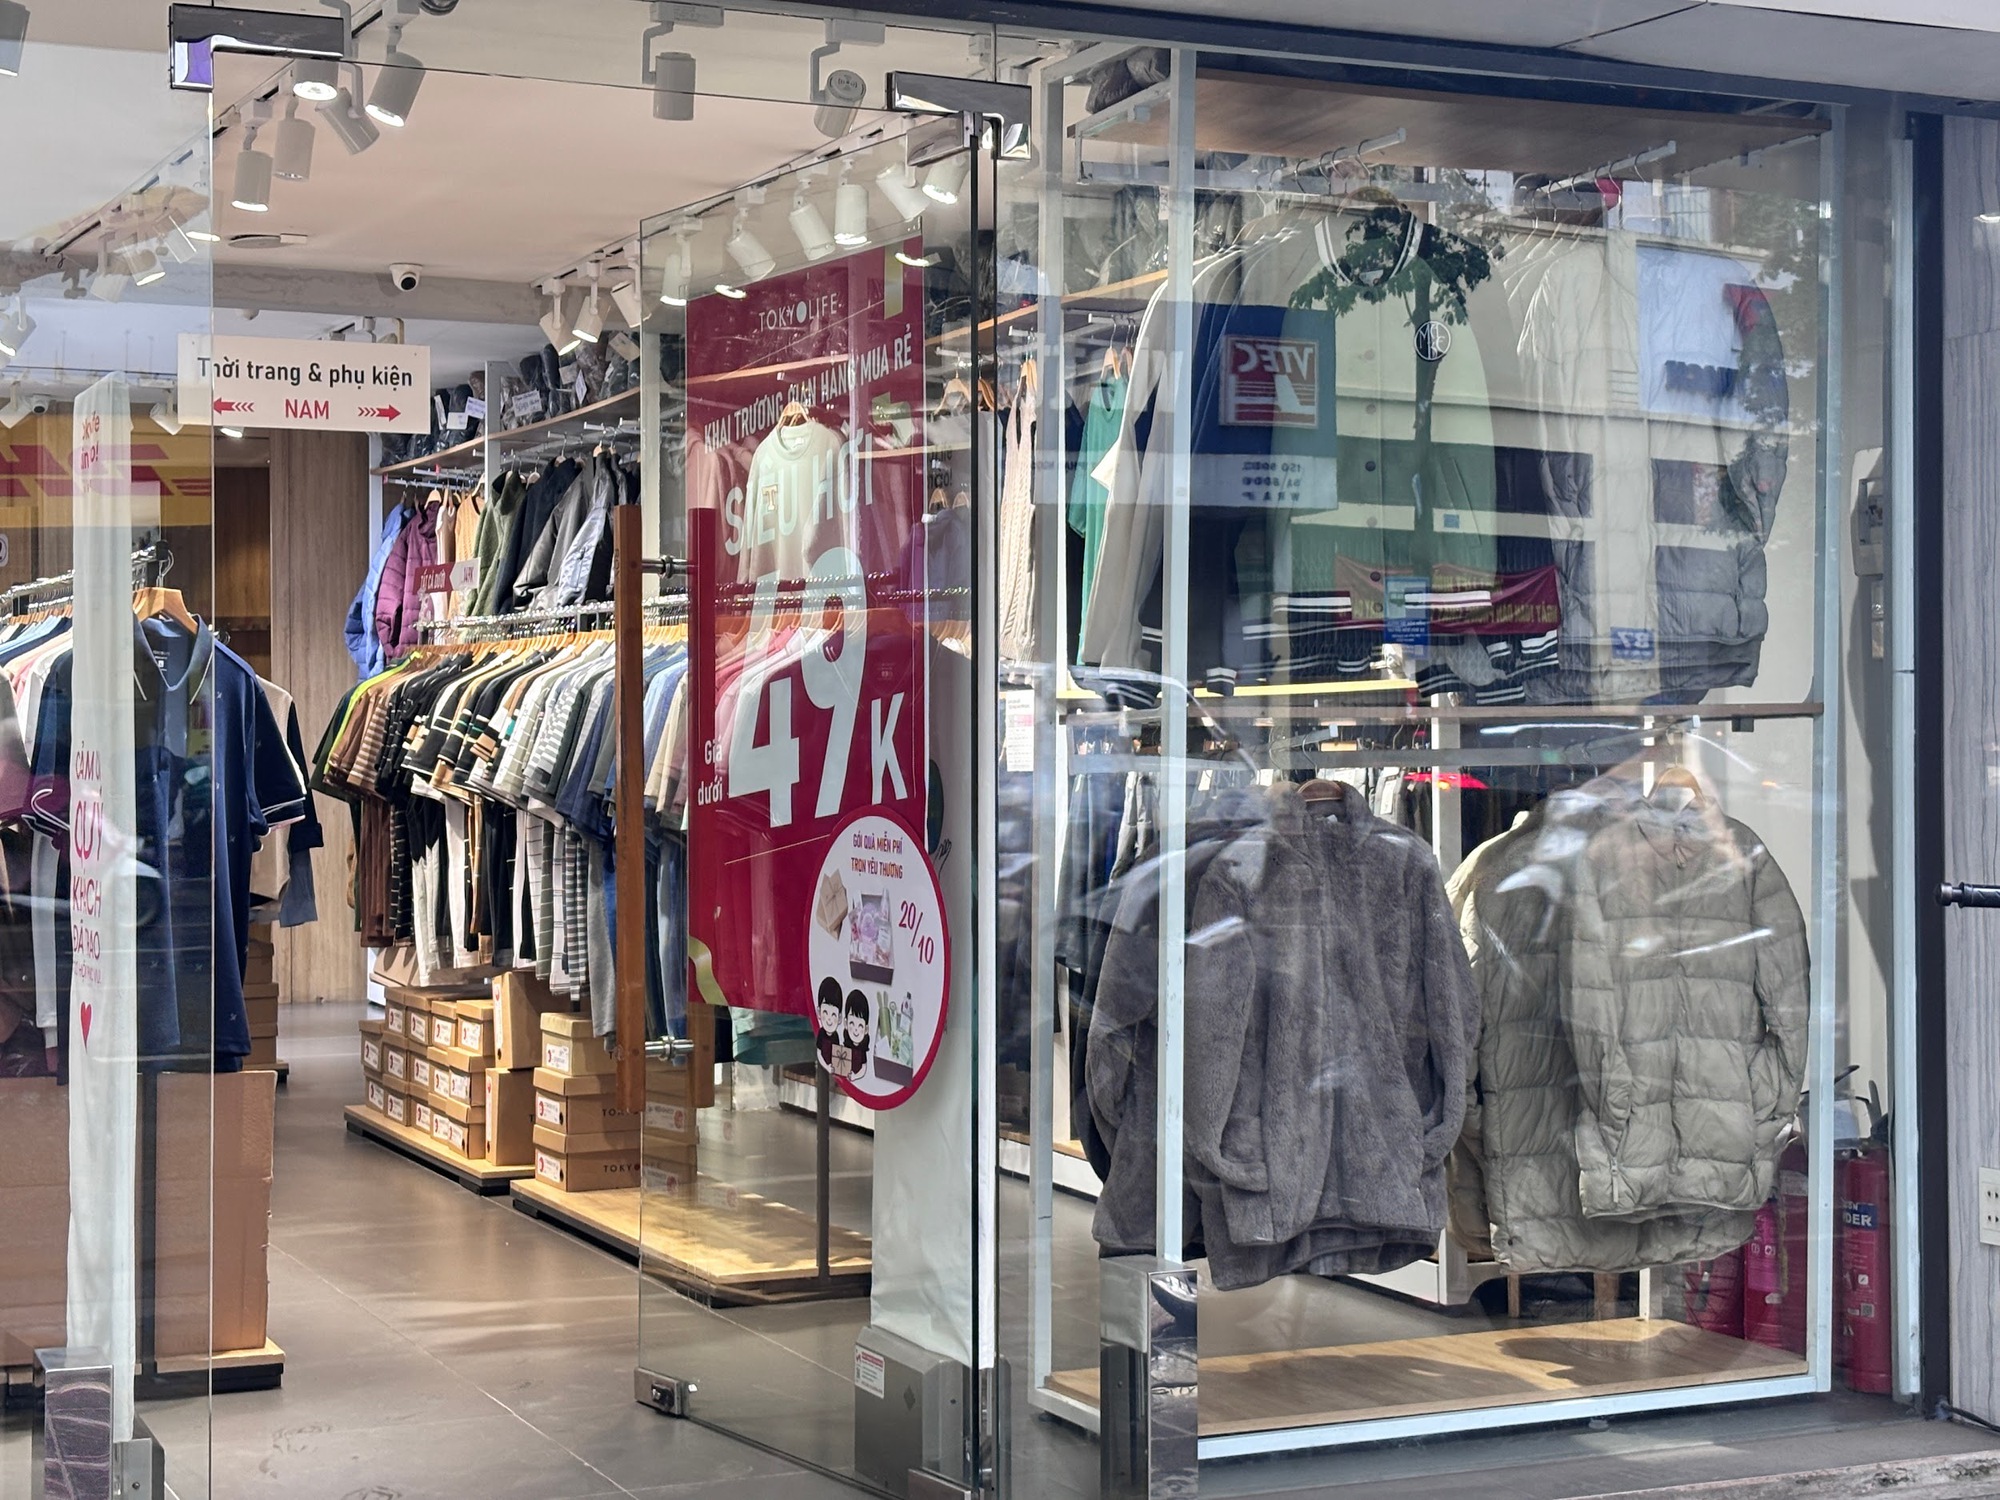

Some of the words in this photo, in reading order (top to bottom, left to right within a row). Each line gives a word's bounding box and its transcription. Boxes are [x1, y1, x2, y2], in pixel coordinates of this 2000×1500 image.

[758, 293, 838, 333] TOKYOLIFE
[197, 356, 240, 379] Thời
[247, 360, 300, 386] trang
[308, 362, 323, 381] &
[329, 363, 365, 390] phụ
[372, 364, 412, 391] kiện
[704, 414, 731, 454] KHAI
[734, 391, 783, 441] TRƯƠNG
[821, 351, 857, 404] HÀNG
[860, 343, 889, 386] MUA
[894, 323, 912, 371] RẺ
[285, 399, 330, 420] NAM
[725, 454, 799, 556] SIÊU
[762, 484, 778, 511] T
[704, 739, 723, 765] Giá
[698, 775, 723, 806] dưới
[853, 830, 863, 848] GÓI
[864, 832, 875, 850] QUÀ
[892, 837, 903, 855] PHÍ
